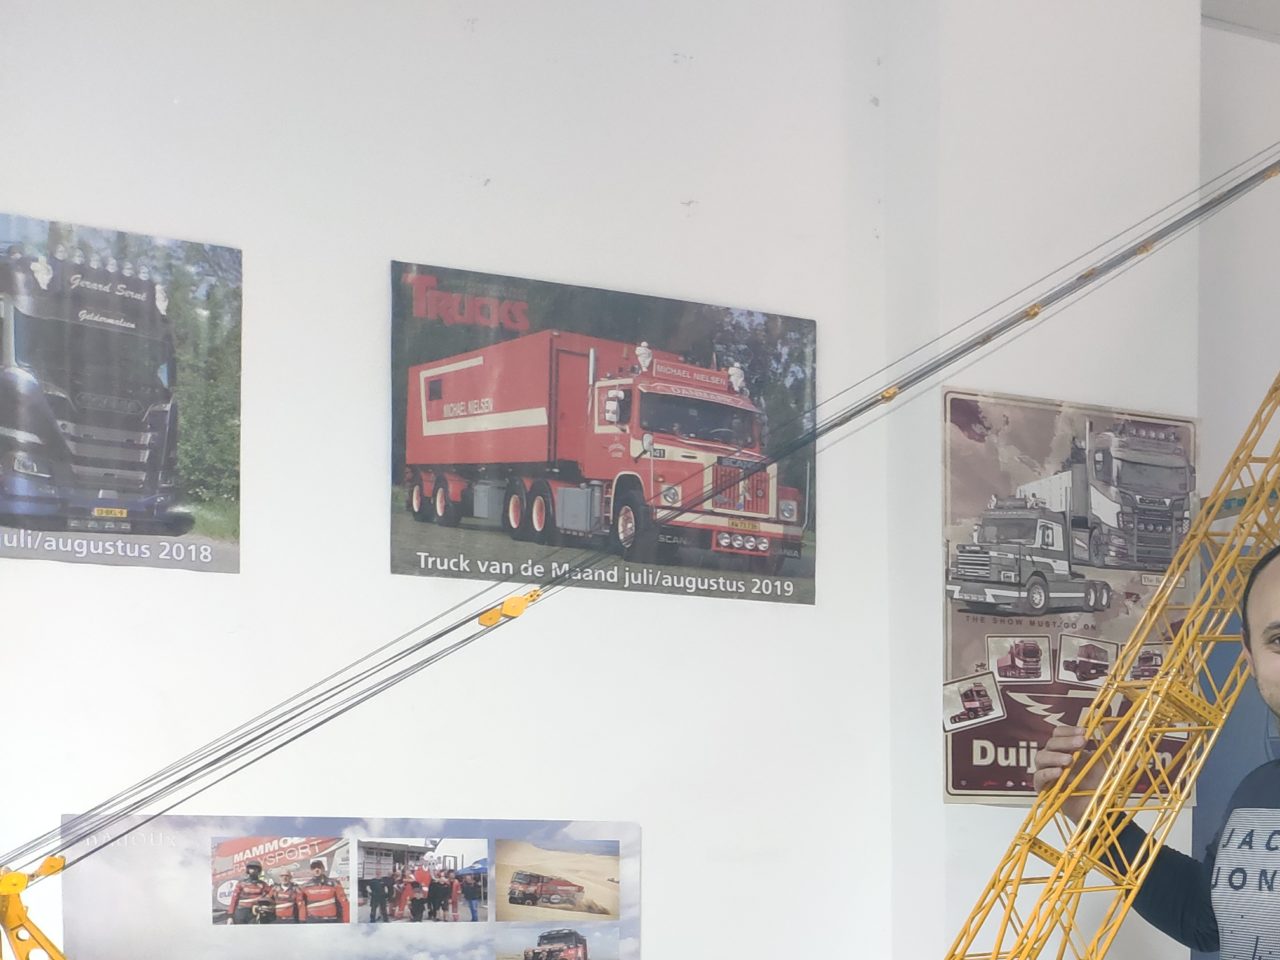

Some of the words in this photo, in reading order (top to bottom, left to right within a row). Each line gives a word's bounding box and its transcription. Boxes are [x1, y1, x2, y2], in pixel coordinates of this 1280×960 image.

[70, 274, 112, 293] Gerard
[656, 364, 691, 379] MICHAEL
[692, 373, 726, 386] NIELSEN
[2, 528, 151, 558] uli/augustus
[158, 541, 213, 563] 2018
[416, 551, 470, 572] Truck
[477, 560, 514, 575] van
[520, 559, 545, 577] de
[551, 562, 618, 583] Maand
[623, 567, 746, 593] juli/augustus
[751, 578, 794, 597] 2019
[965, 615, 985, 624] THE
[992, 617, 1023, 626] SHOW
[1063, 621, 1078, 630] GO
[1083, 623, 1097, 631] ON
